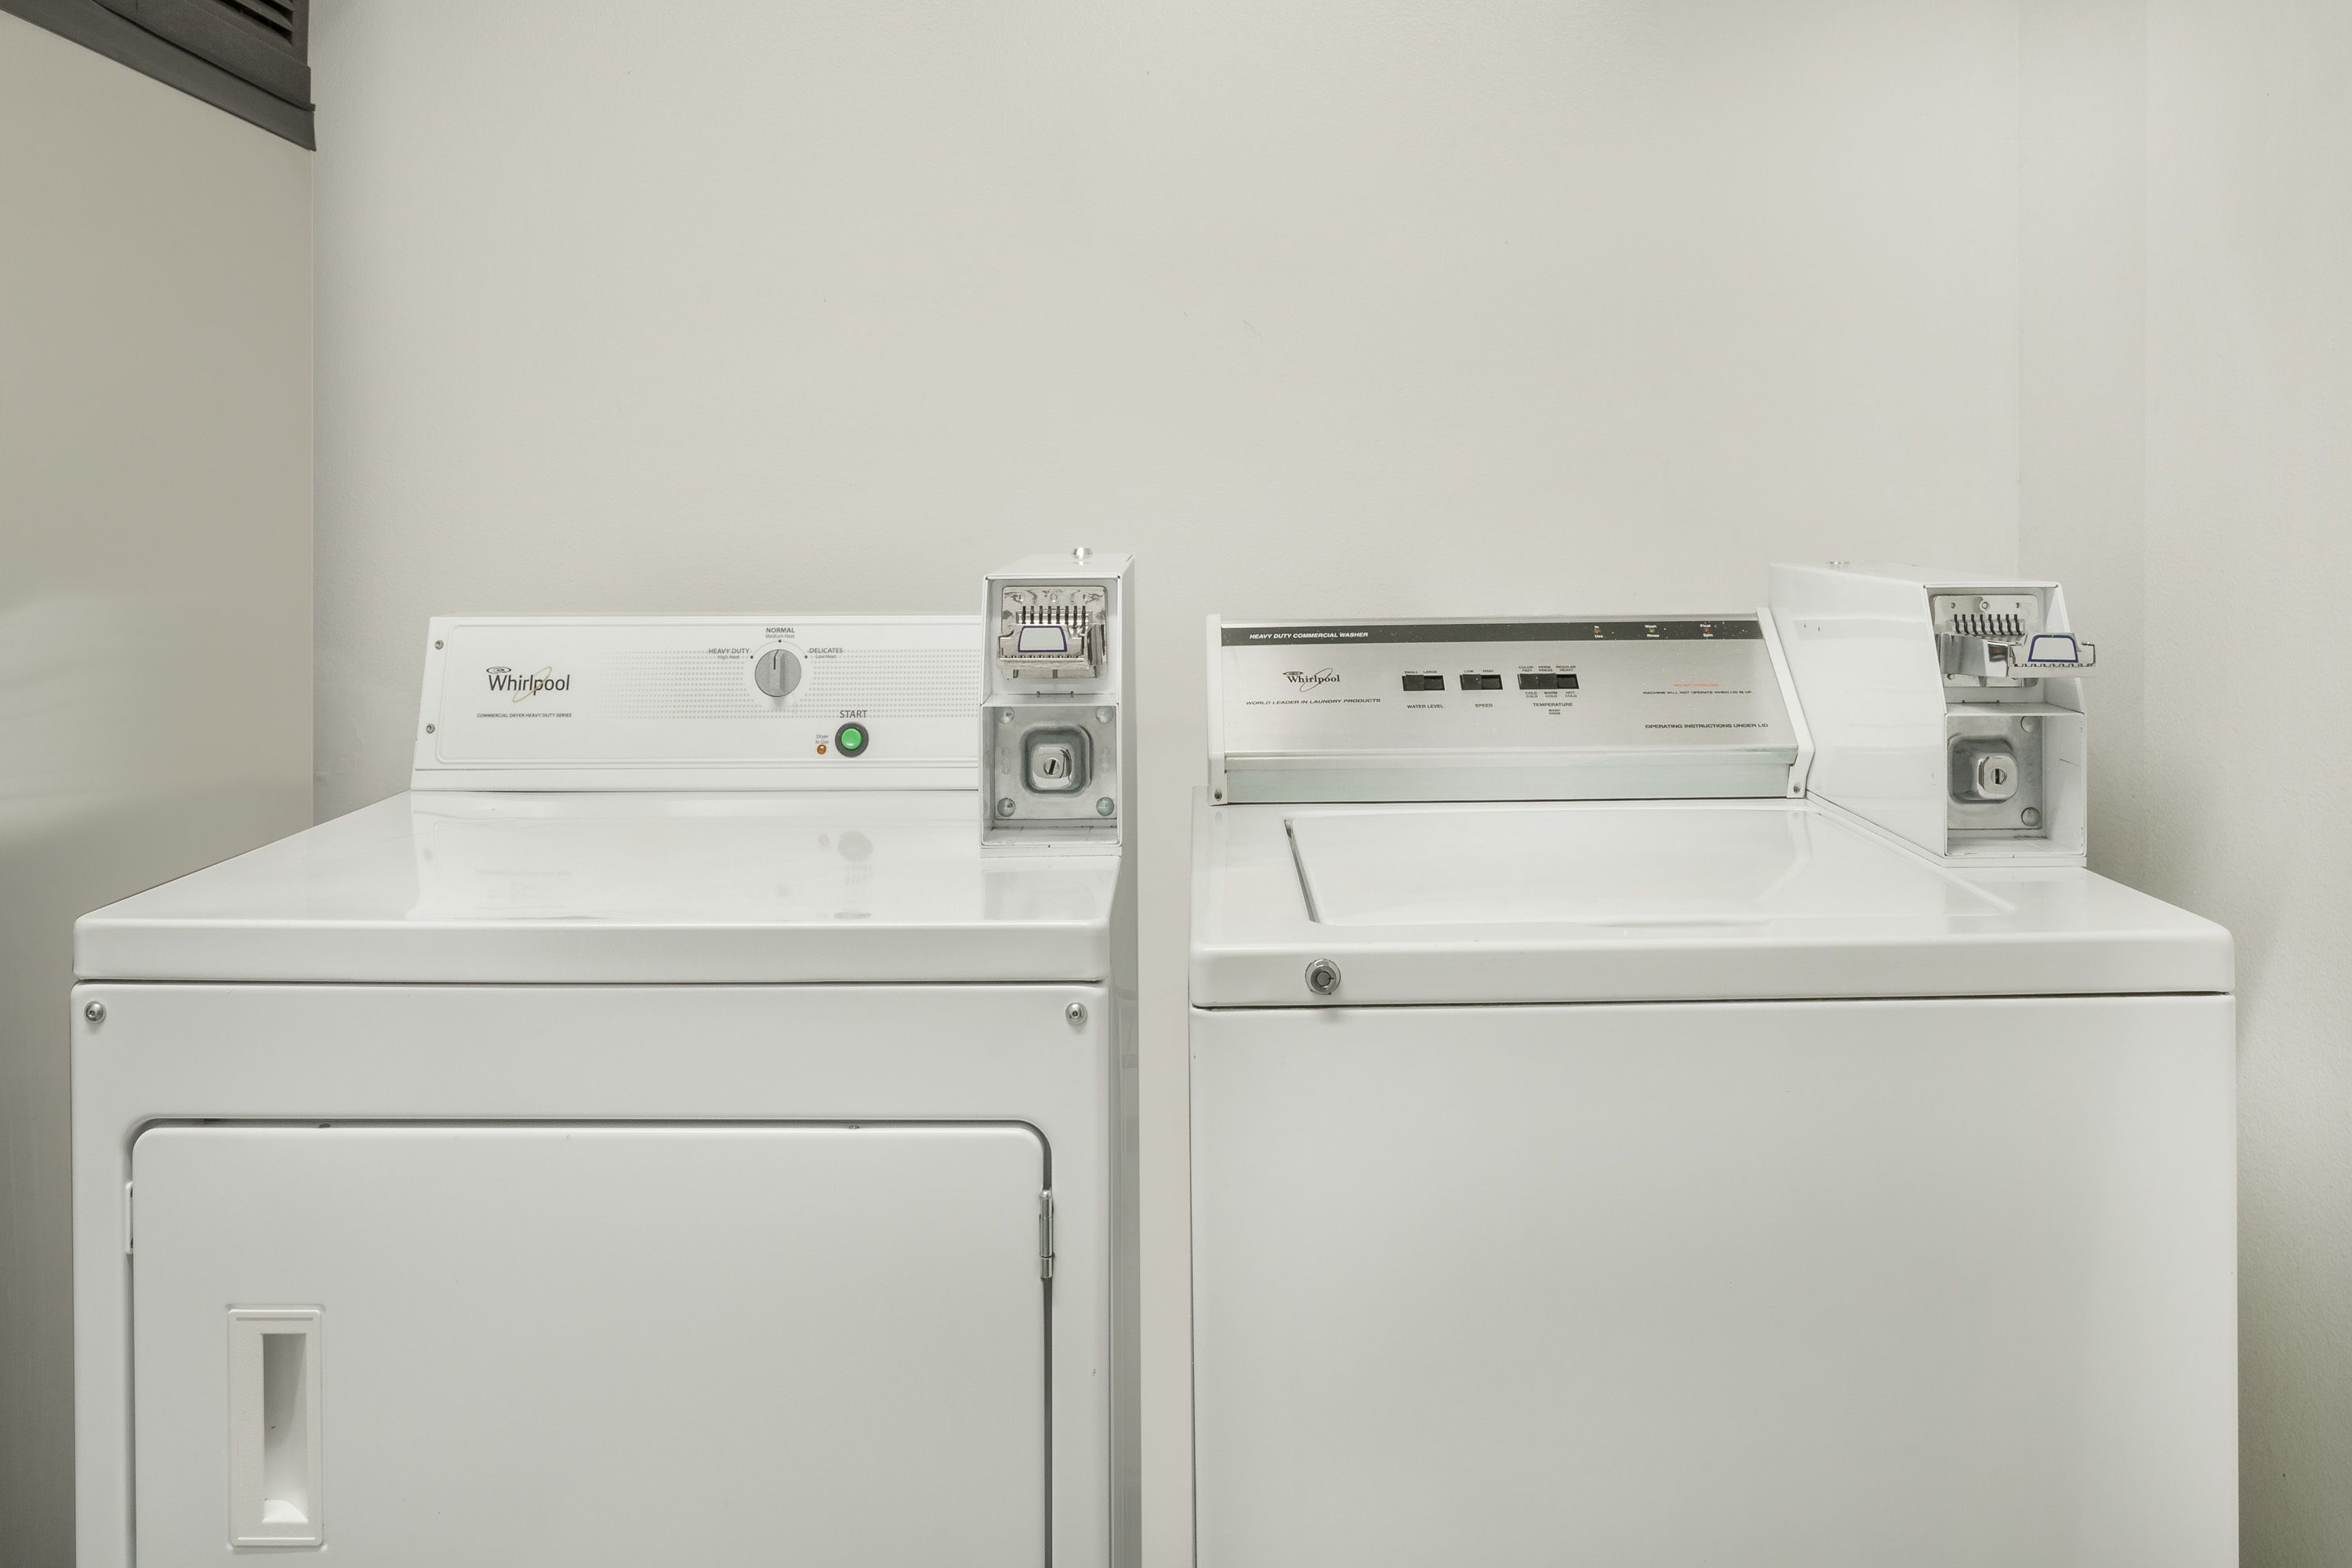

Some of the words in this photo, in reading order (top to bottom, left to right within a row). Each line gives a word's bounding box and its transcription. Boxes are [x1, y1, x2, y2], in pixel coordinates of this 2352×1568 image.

[488, 673, 570, 695] Whirlpool
[1287, 674, 1341, 684] Whirlpool
[840, 710, 868, 718] START
